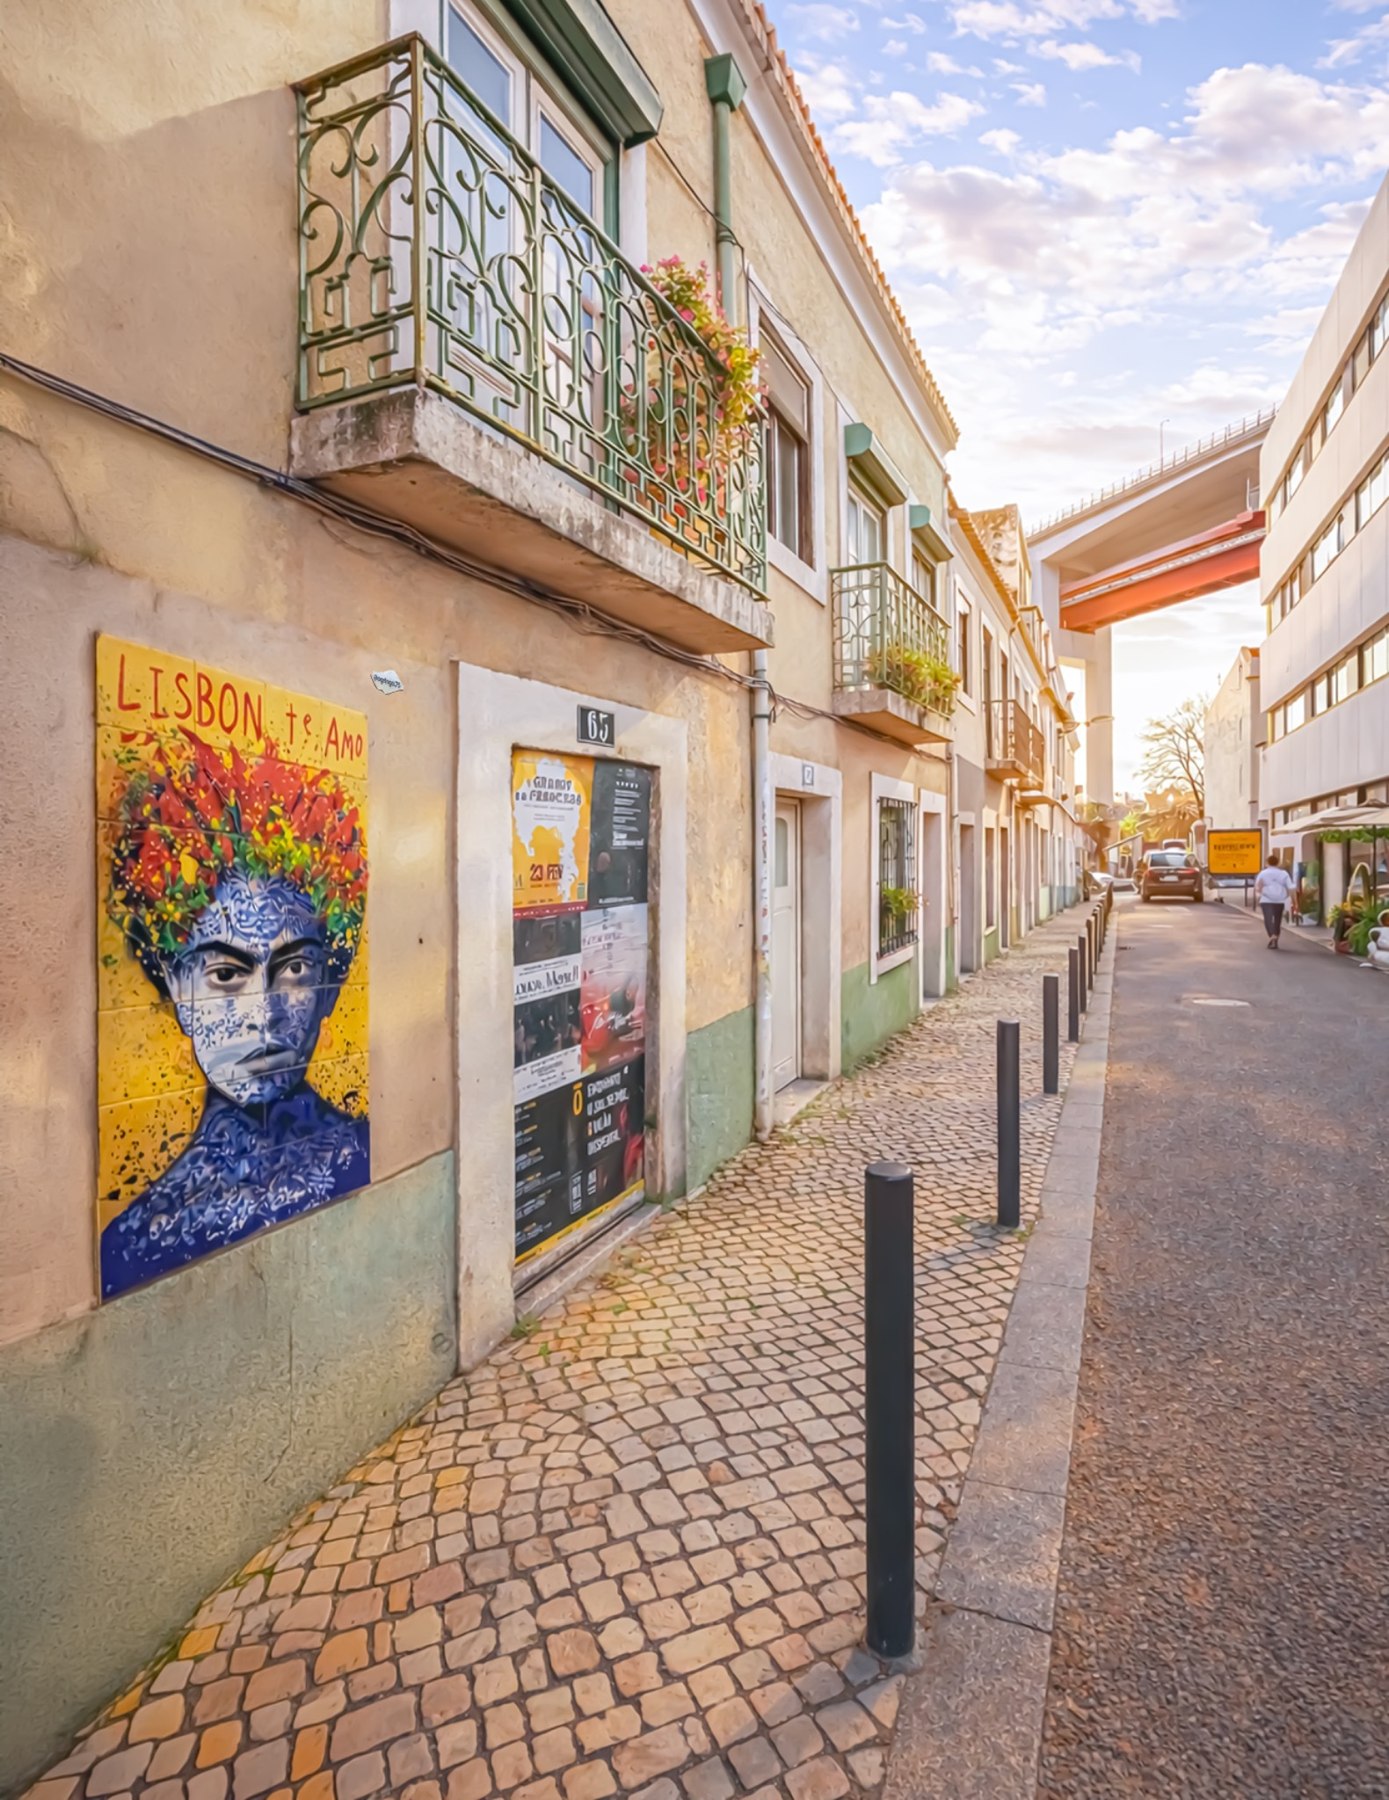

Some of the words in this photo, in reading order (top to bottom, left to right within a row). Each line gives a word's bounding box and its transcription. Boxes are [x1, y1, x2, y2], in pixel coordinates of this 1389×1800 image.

[117, 653, 263, 742] LISBON
[285, 703, 312, 745] te
[587, 710, 609, 743] 65
